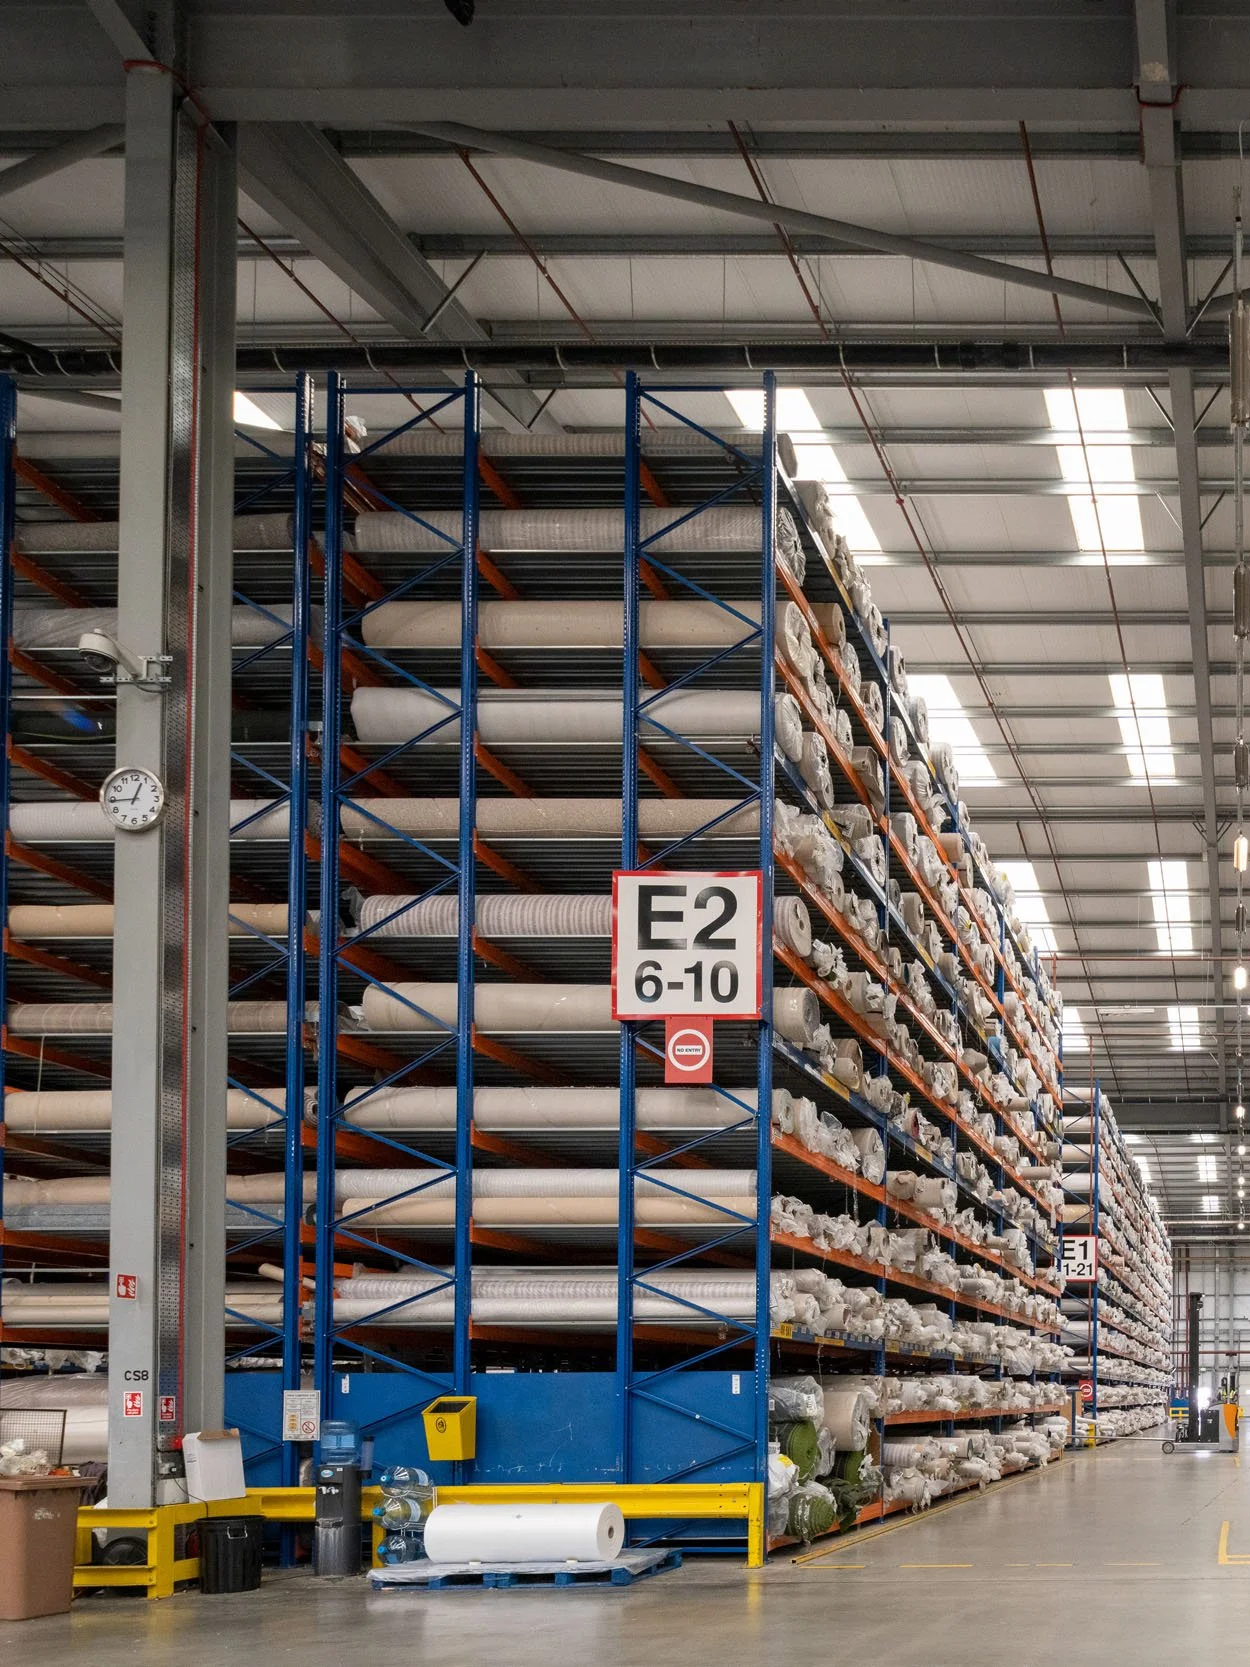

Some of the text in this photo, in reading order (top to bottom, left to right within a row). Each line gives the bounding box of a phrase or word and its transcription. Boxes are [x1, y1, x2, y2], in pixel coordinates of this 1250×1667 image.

[130, 774, 140, 782] 12
[151, 785, 157, 793] 2
[113, 806, 119, 814] 8
[121, 814, 127, 822] 7
[131, 817, 138, 825] 6
[142, 814, 148, 822] 5
[637, 885, 738, 951] E2
[634, 960, 739, 1004] 6-10
[1062, 1239, 1088, 1260] E1
[1063, 1262, 1093, 1276] 1-21
[124, 1369, 150, 1382] CS8
